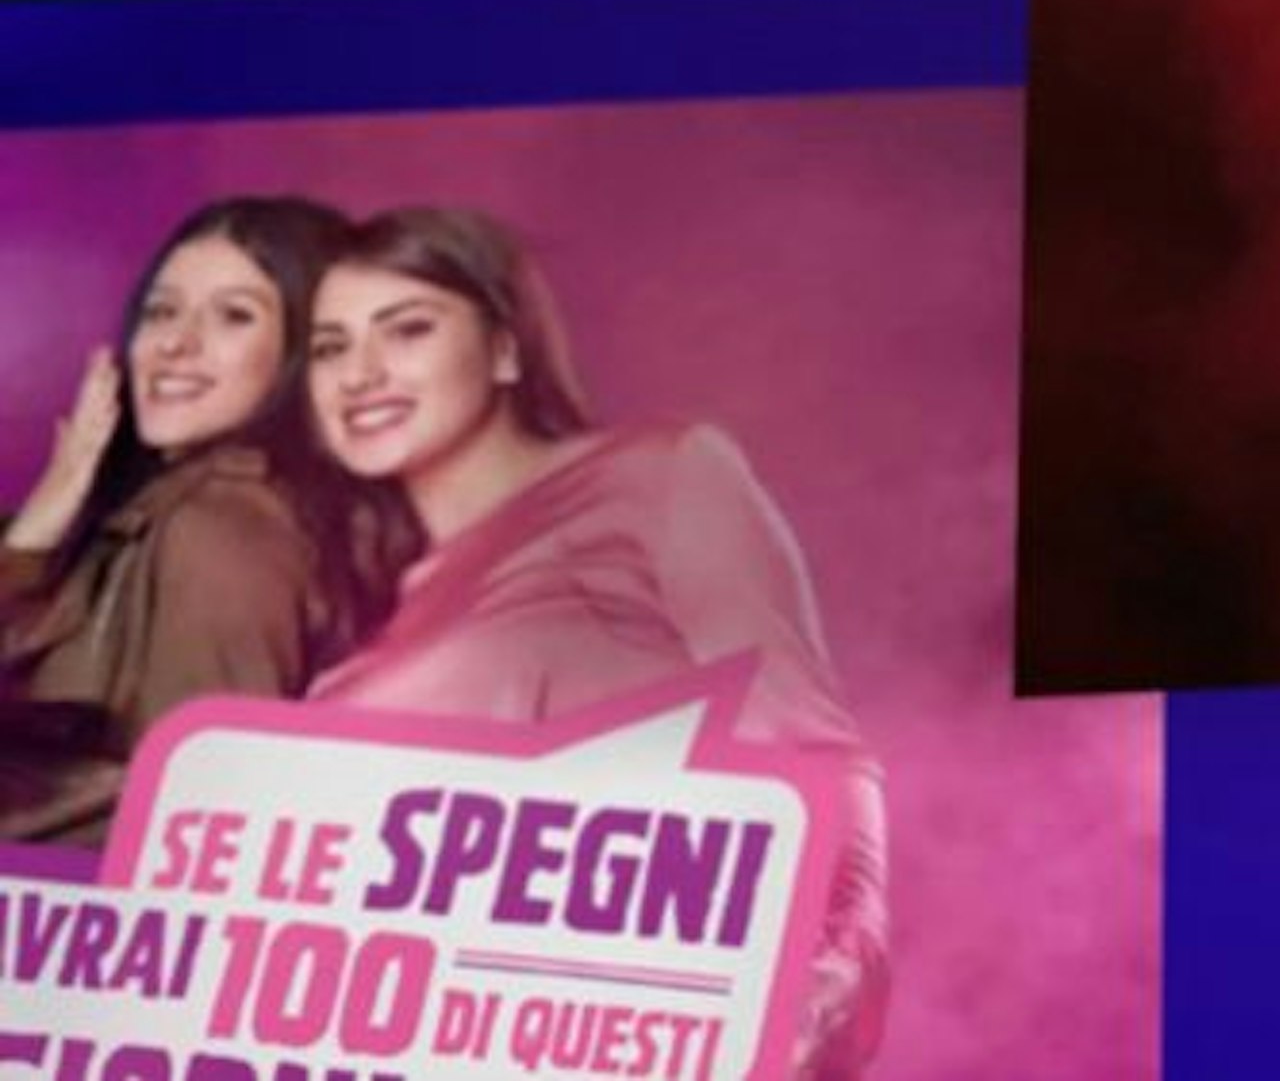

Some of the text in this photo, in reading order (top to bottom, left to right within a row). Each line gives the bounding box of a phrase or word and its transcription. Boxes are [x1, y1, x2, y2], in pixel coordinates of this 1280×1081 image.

[152, 789, 774, 948] SE LE SPEGNI
[0, 892, 208, 999] VRAI
[207, 915, 439, 1056] 100
[431, 987, 493, 1060] DI
[508, 992, 724, 1081] QUESTI
